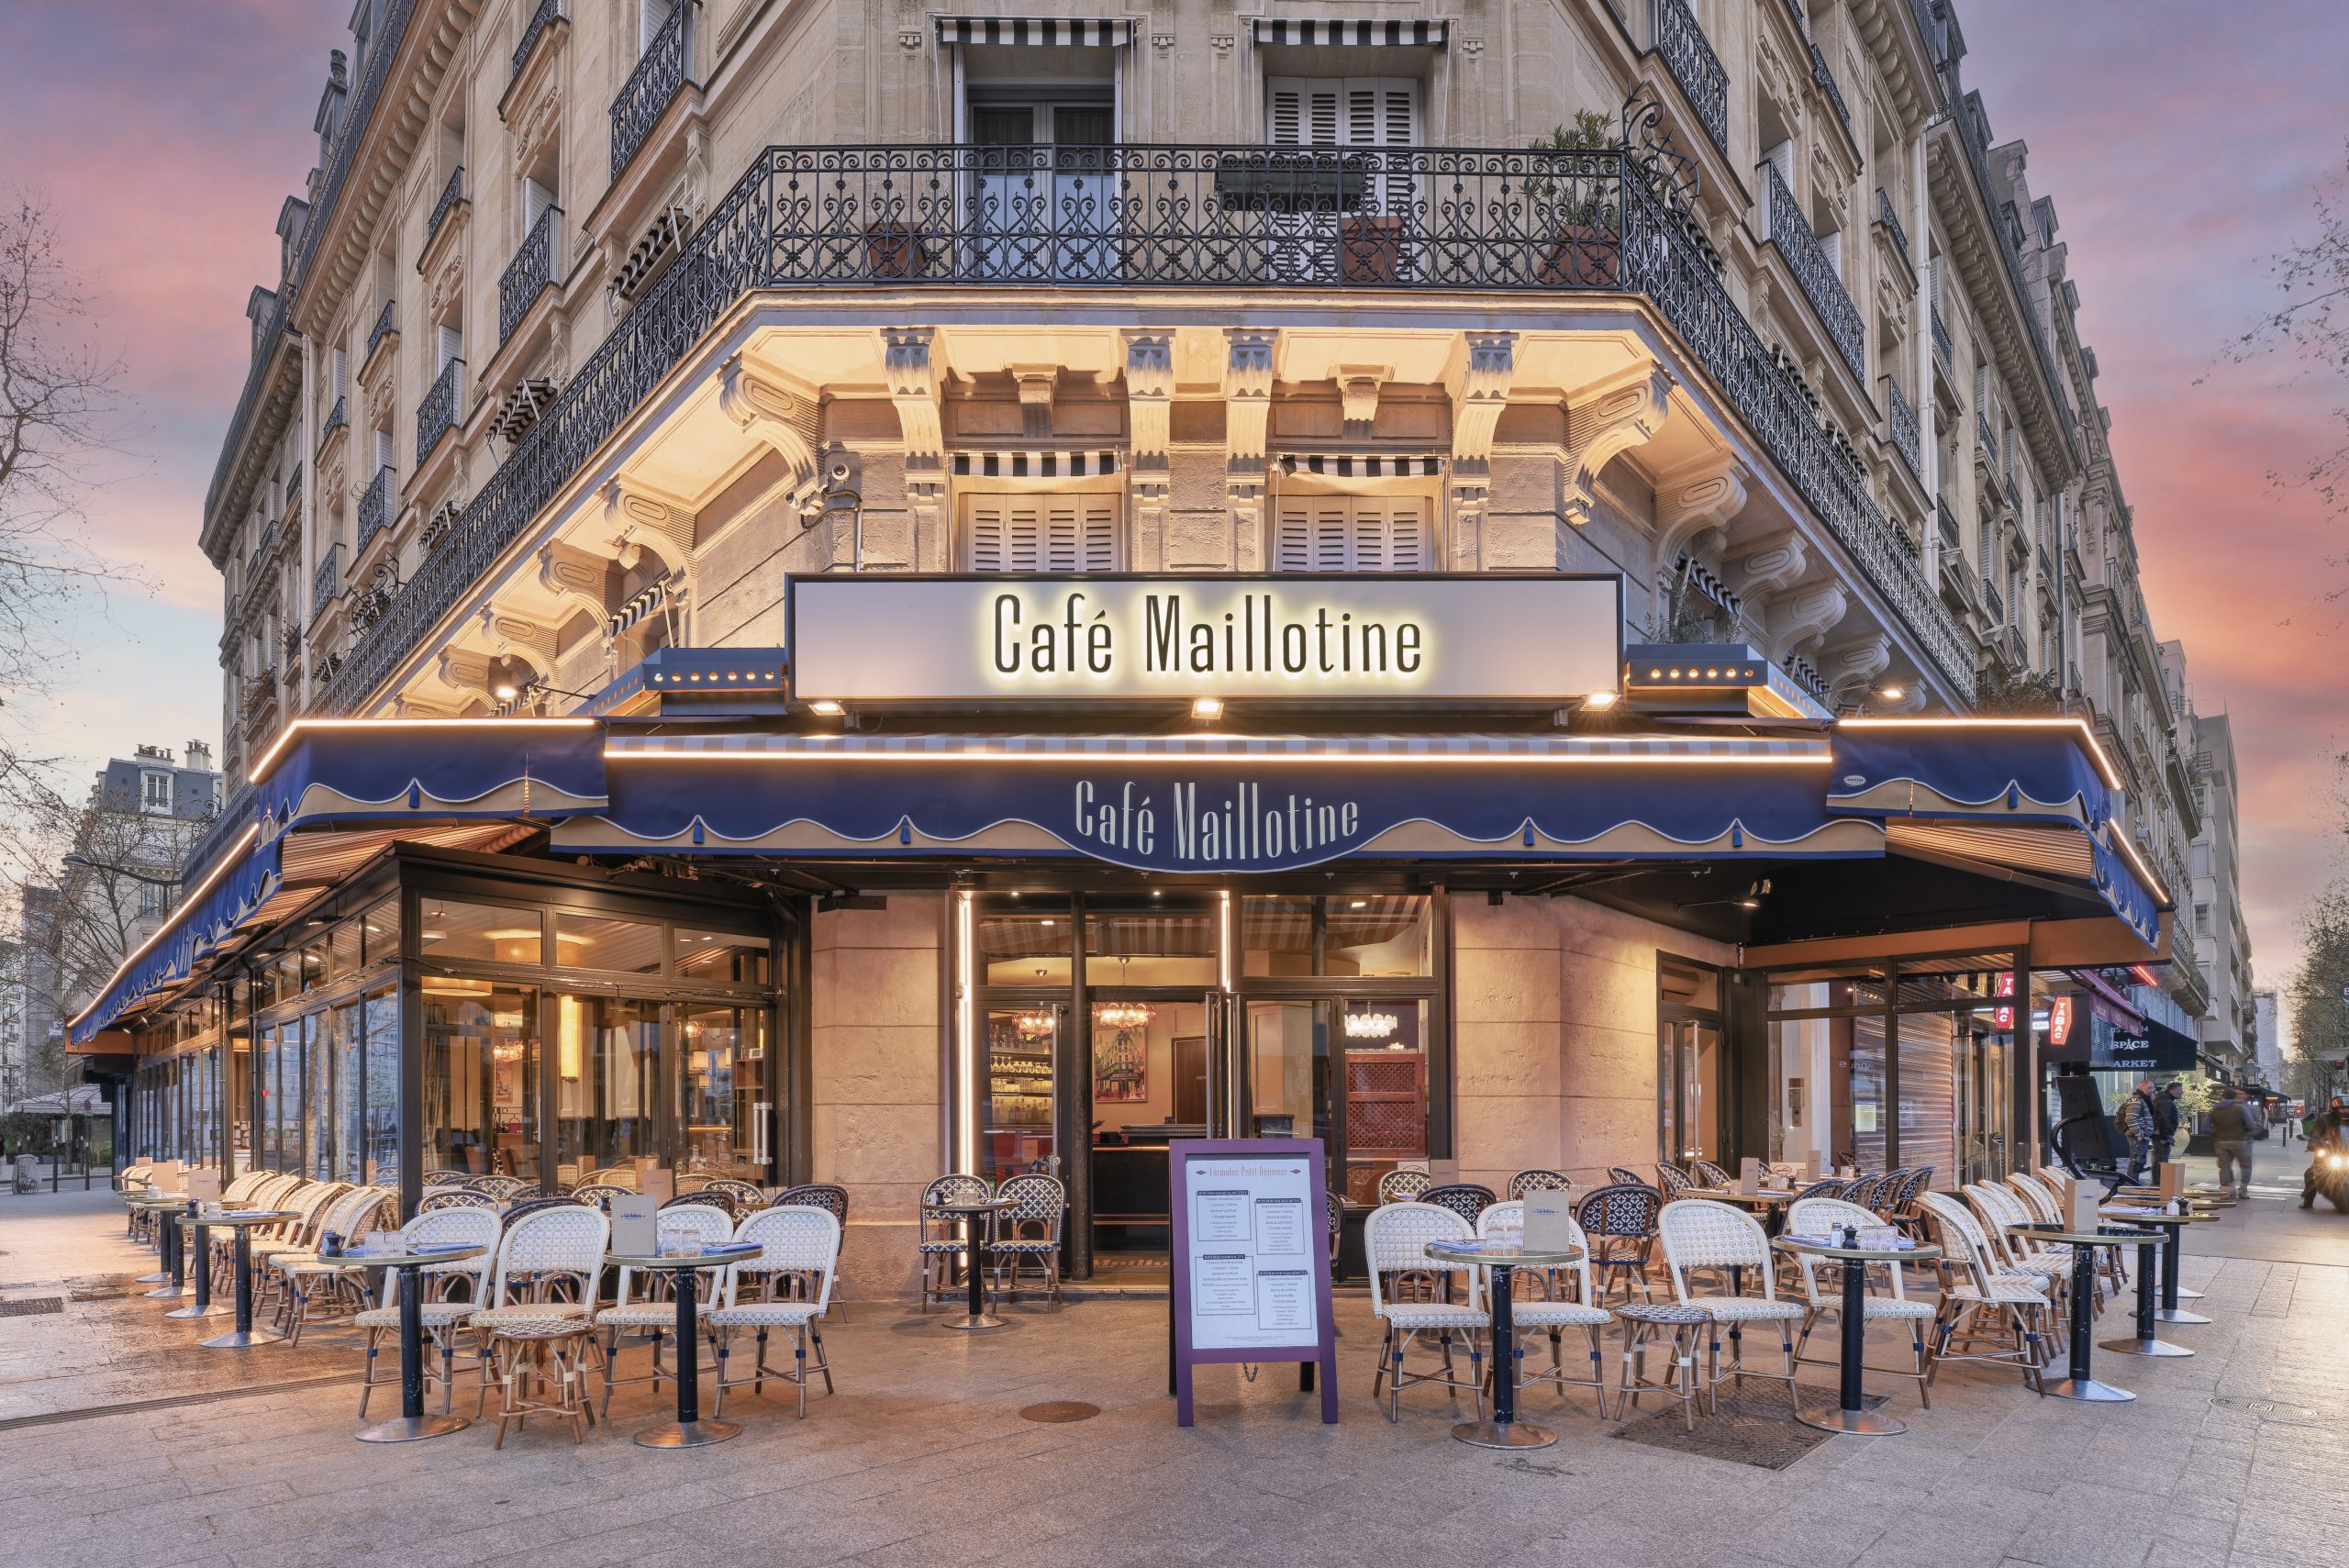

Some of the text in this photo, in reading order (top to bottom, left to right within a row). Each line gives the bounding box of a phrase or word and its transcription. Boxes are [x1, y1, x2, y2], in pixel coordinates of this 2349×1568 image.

[995, 593, 1422, 673] Café Maillotine
[1075, 780, 1358, 861] Café Maillotine
[1999, 978, 2014, 1022] TAAC
[2054, 1002, 2066, 1040] TABAC
[2113, 1059, 2157, 1068] ARKET
